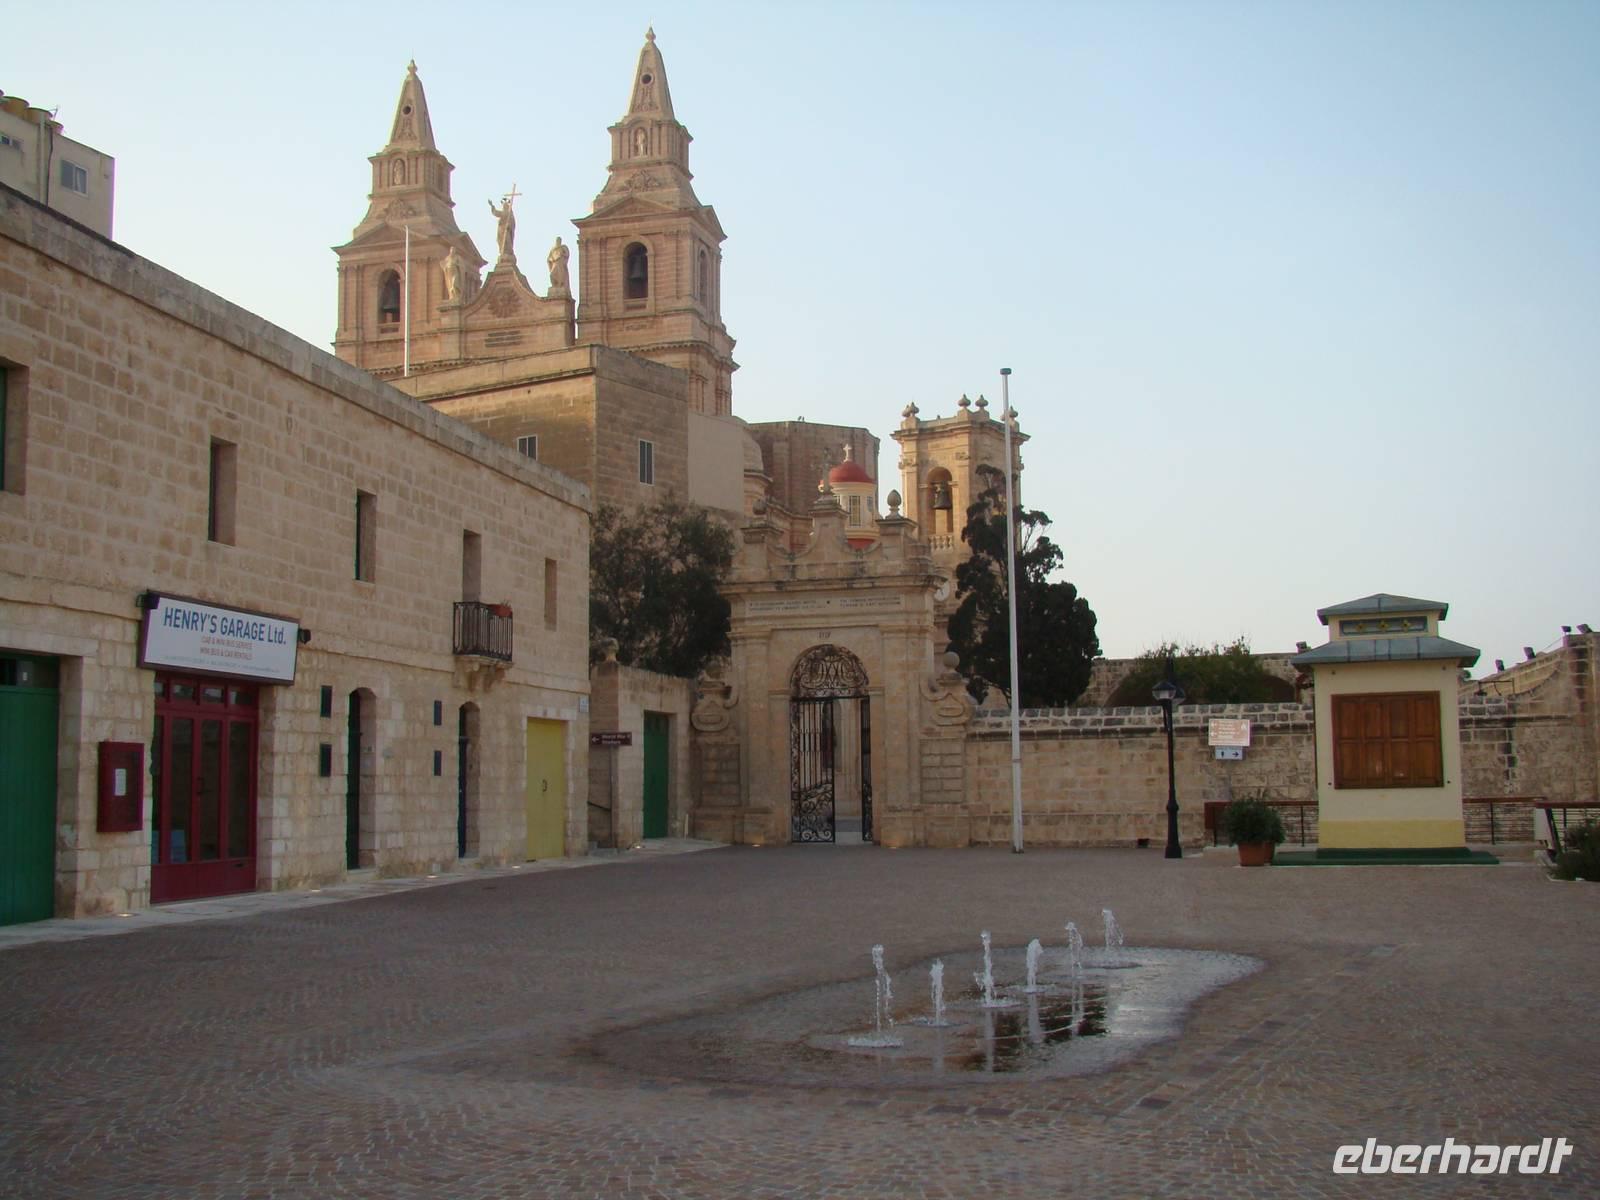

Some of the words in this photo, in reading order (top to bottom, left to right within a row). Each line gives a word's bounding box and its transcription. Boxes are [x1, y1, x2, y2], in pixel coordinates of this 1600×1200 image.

[163, 606, 218, 634] HENRY'S
[220, 617, 266, 641] GARAGE
[267, 624, 287, 645] Ltd.
